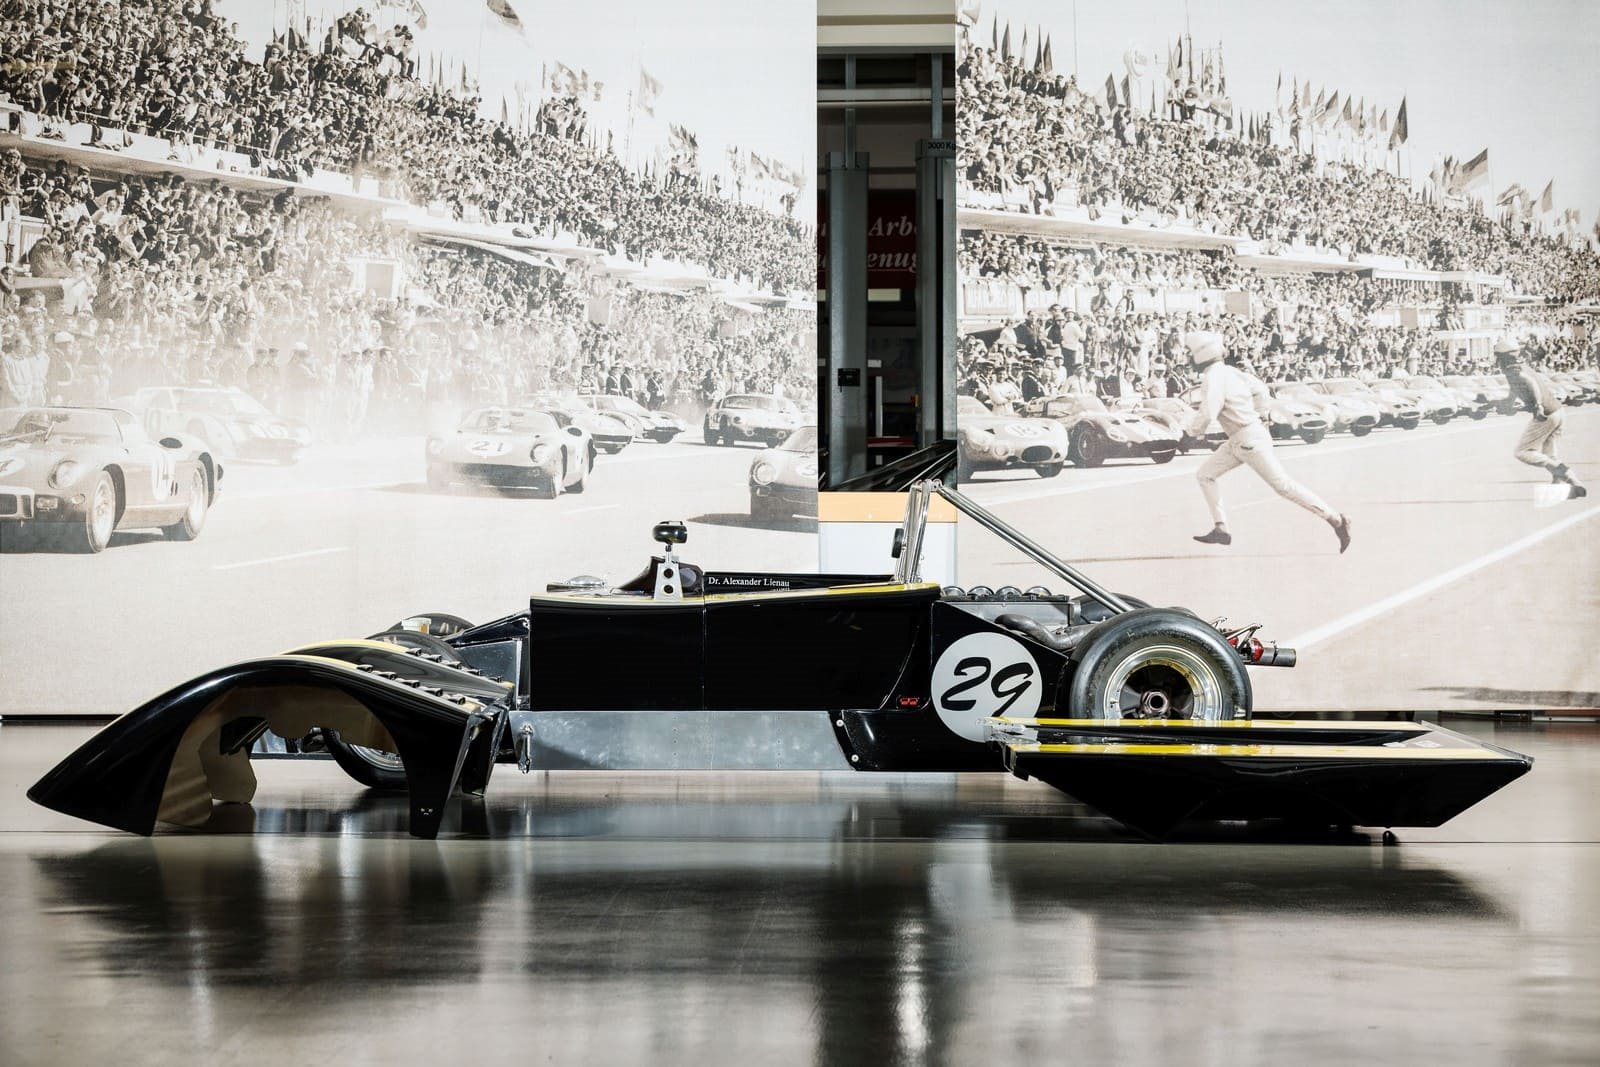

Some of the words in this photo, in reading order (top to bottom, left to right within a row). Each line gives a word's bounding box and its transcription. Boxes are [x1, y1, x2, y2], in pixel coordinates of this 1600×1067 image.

[868, 216, 917, 237] Arb
[471, 440, 504, 452] 21
[708, 576, 721, 585] Dr.
[722, 577, 762, 586] Alexander
[763, 578, 790, 587] Lienau
[940, 656, 1034, 718] 29
